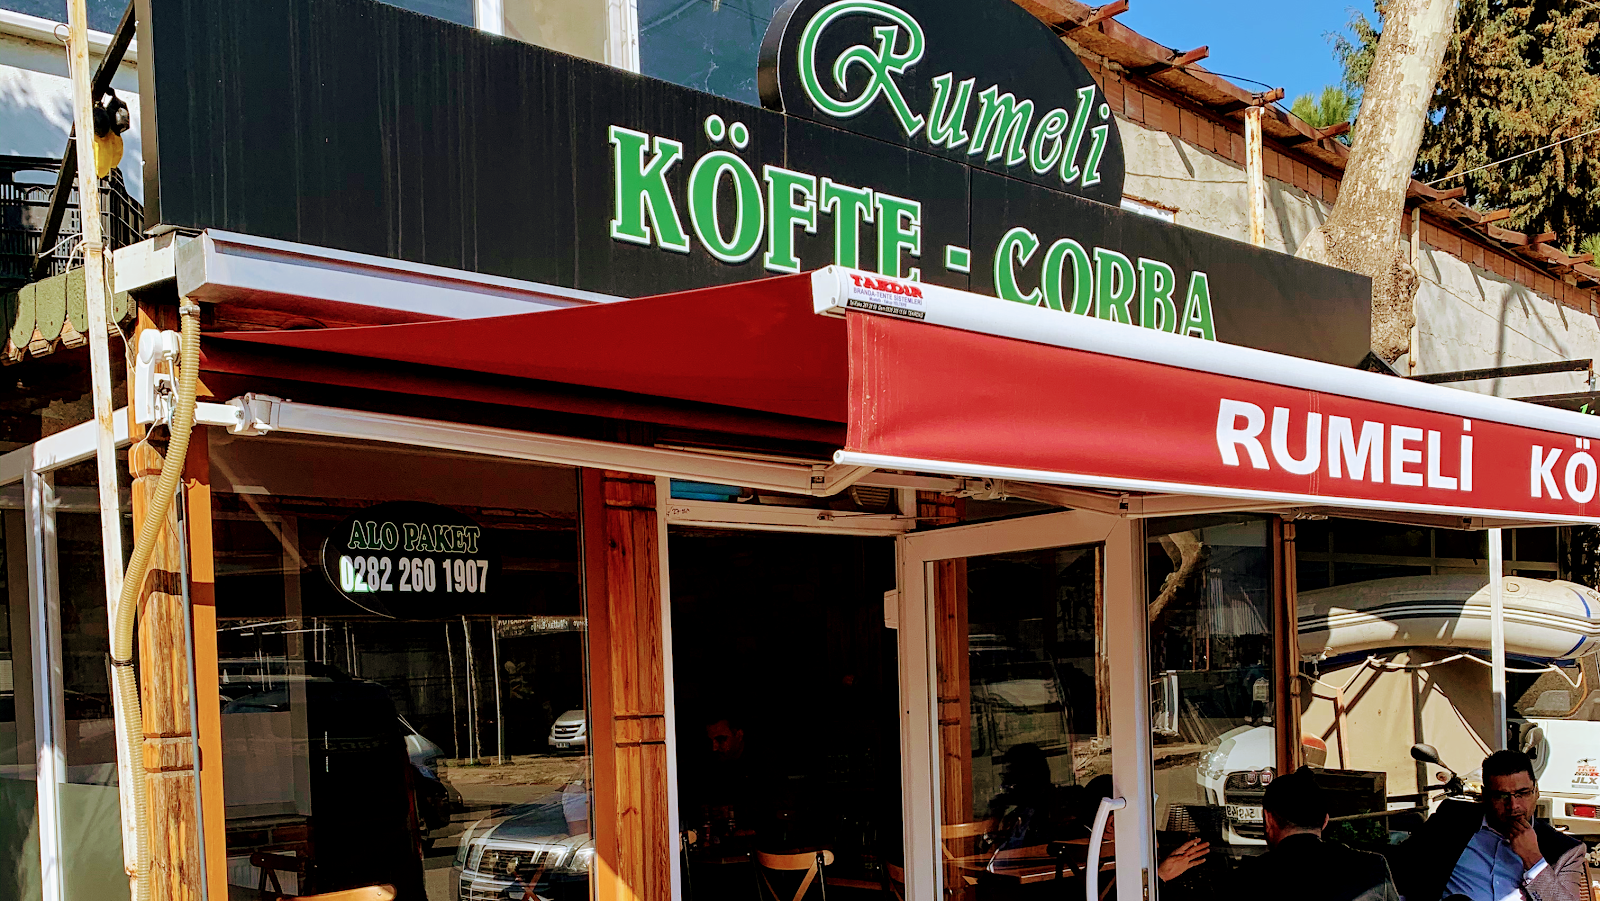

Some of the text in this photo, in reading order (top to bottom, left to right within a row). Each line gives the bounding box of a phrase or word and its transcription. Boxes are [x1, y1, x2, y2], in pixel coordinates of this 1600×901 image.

[798, 0, 1111, 188] Rumeli
[609, 114, 921, 283] KÖFTE
[1216, 398, 1474, 493] RUMELİ
[339, 555, 489, 593] 0282 260 1907
[348, 520, 481, 553] ALO PAKET
